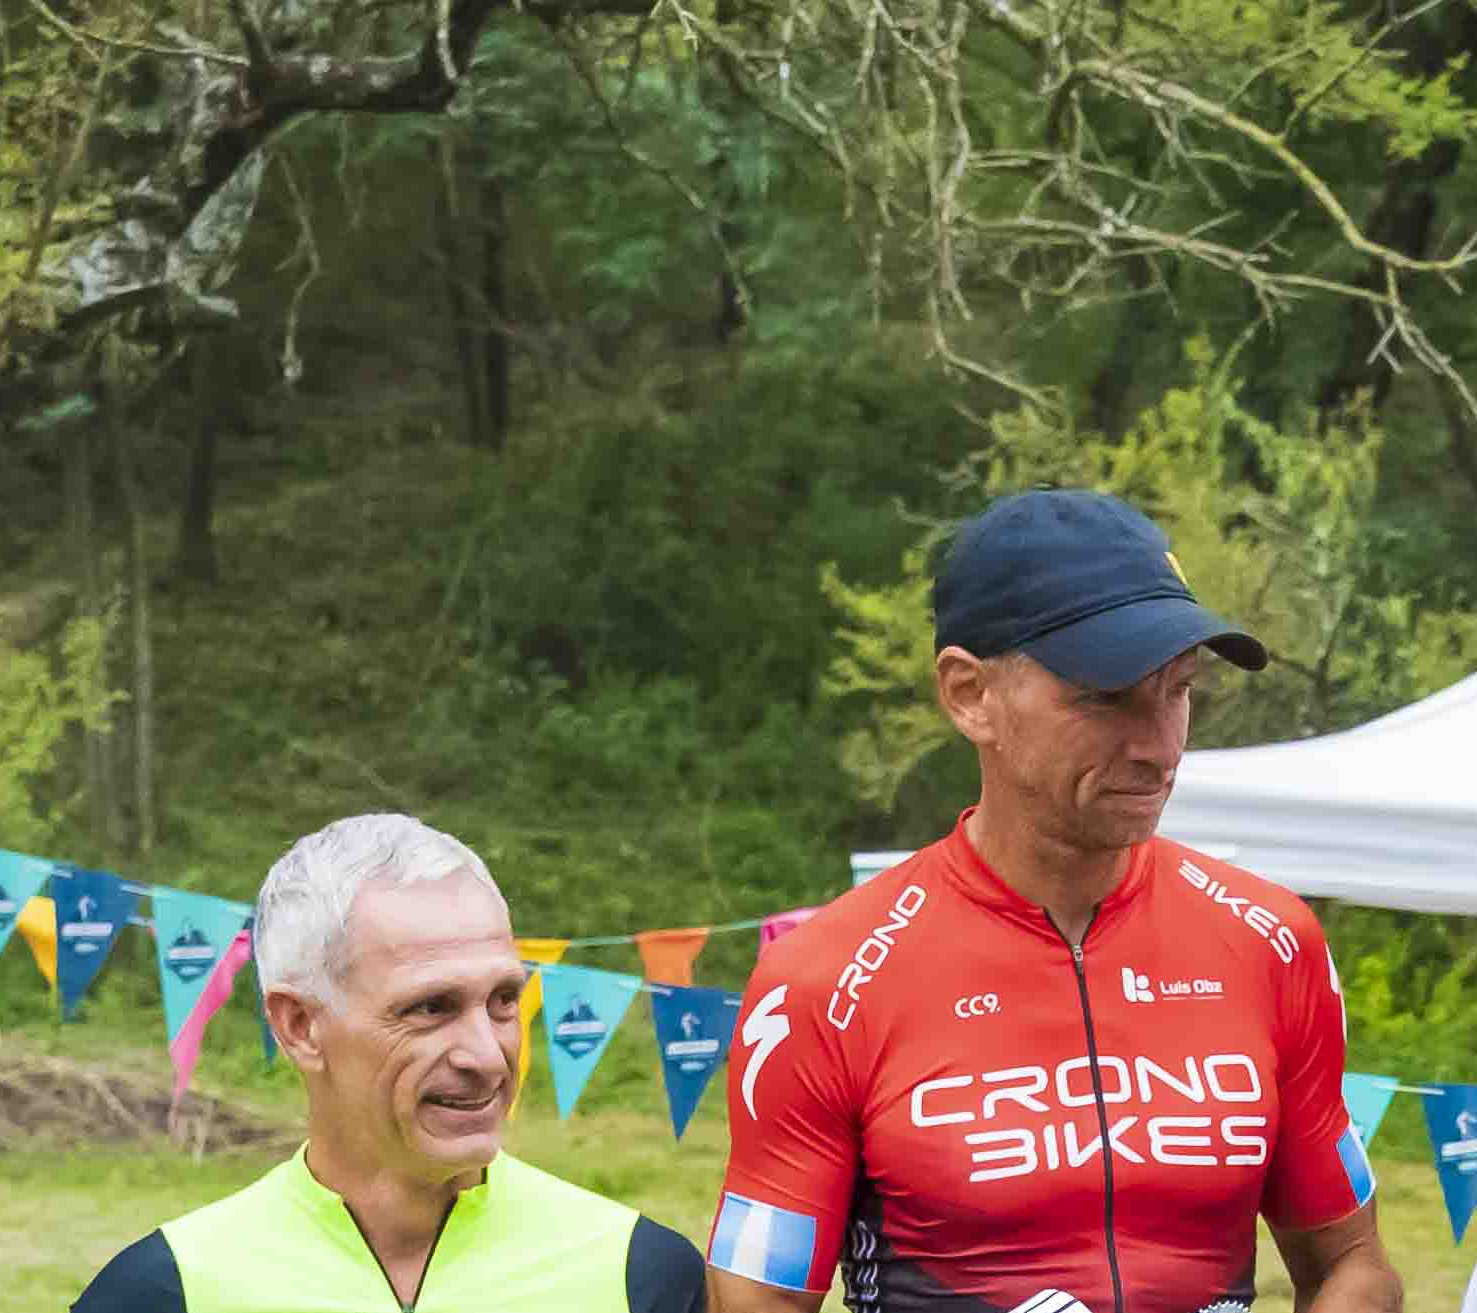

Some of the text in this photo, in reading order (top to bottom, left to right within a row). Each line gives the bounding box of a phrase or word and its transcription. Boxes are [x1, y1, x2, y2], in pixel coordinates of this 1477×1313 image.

[1178, 858, 1300, 965] BIKES
[827, 884, 927, 1032] CRONO
[911, 1053, 1263, 1128] CRONO
[964, 1115, 1267, 1183] BIKES
